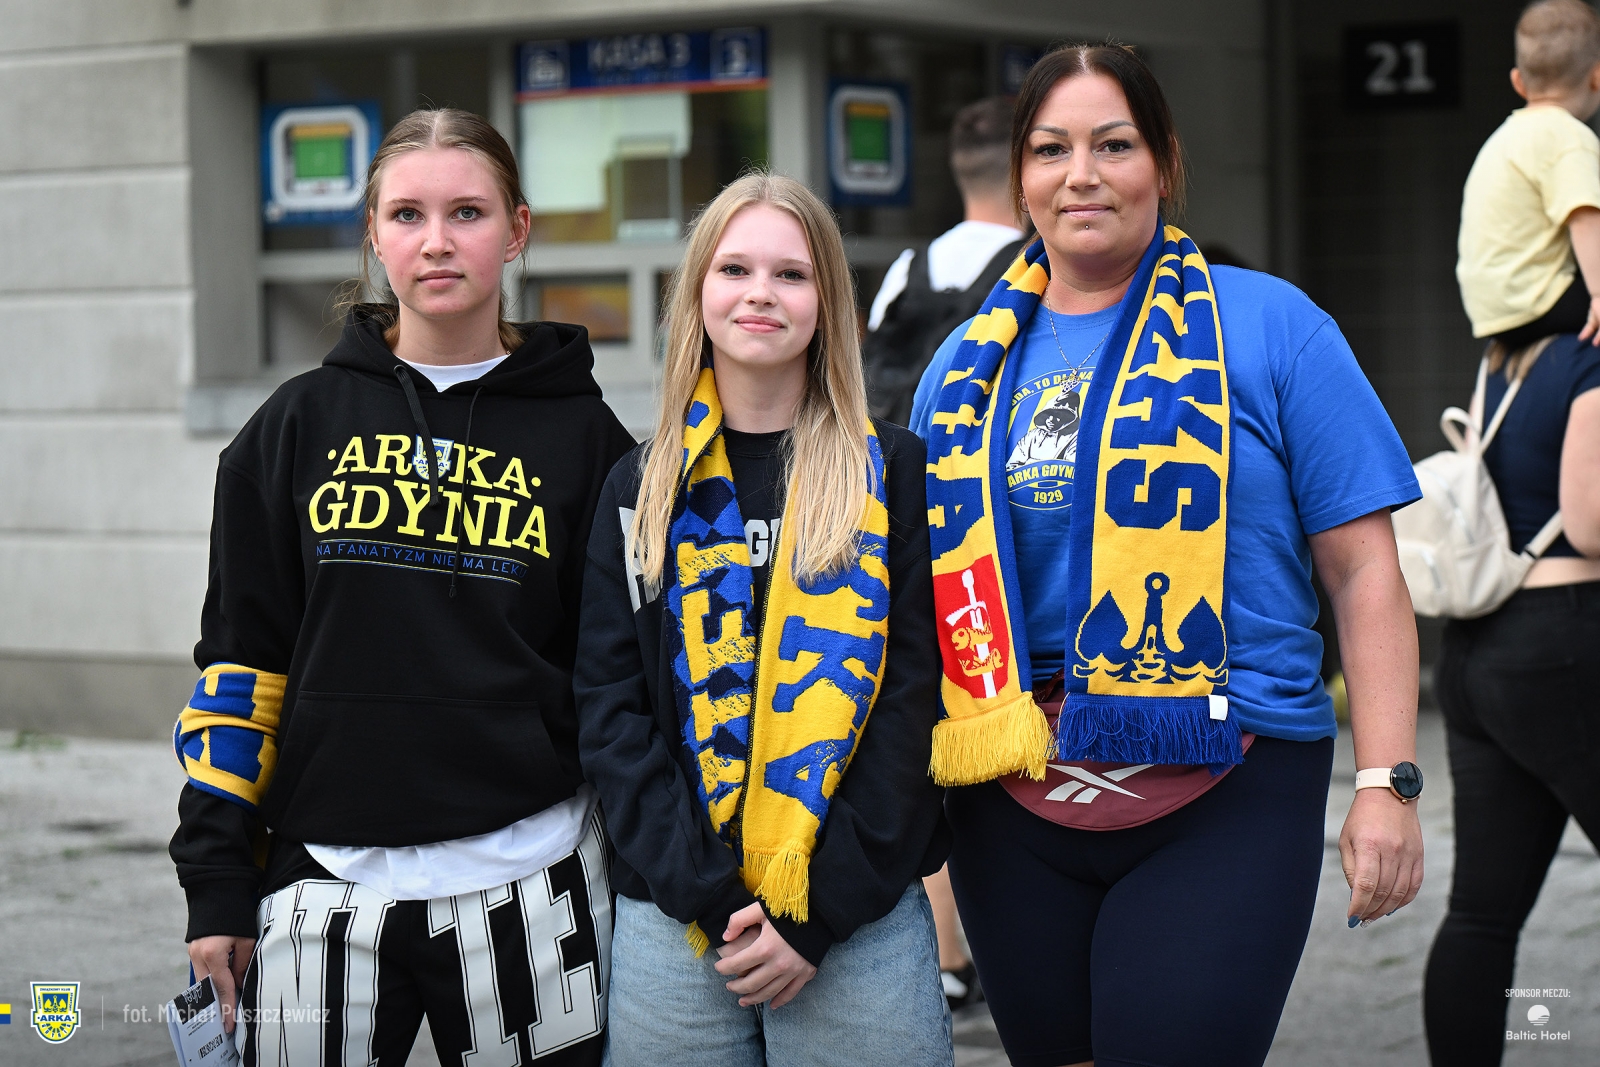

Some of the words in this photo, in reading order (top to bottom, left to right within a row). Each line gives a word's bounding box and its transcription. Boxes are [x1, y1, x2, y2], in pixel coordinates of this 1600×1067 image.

[1365, 40, 1435, 95] 21
[1034, 377, 1050, 390] TO
[1007, 465, 1039, 488] ARKA
[1041, 464, 1075, 480] GDYN
[1033, 489, 1064, 504] 1929
[308, 480, 551, 559] GDYNIA
[316, 544, 331, 557] NA
[337, 543, 425, 563] FANATYZM
[432, 553, 454, 567] NIE
[463, 557, 484, 571] MA
[492, 560, 528, 579] LEKU
